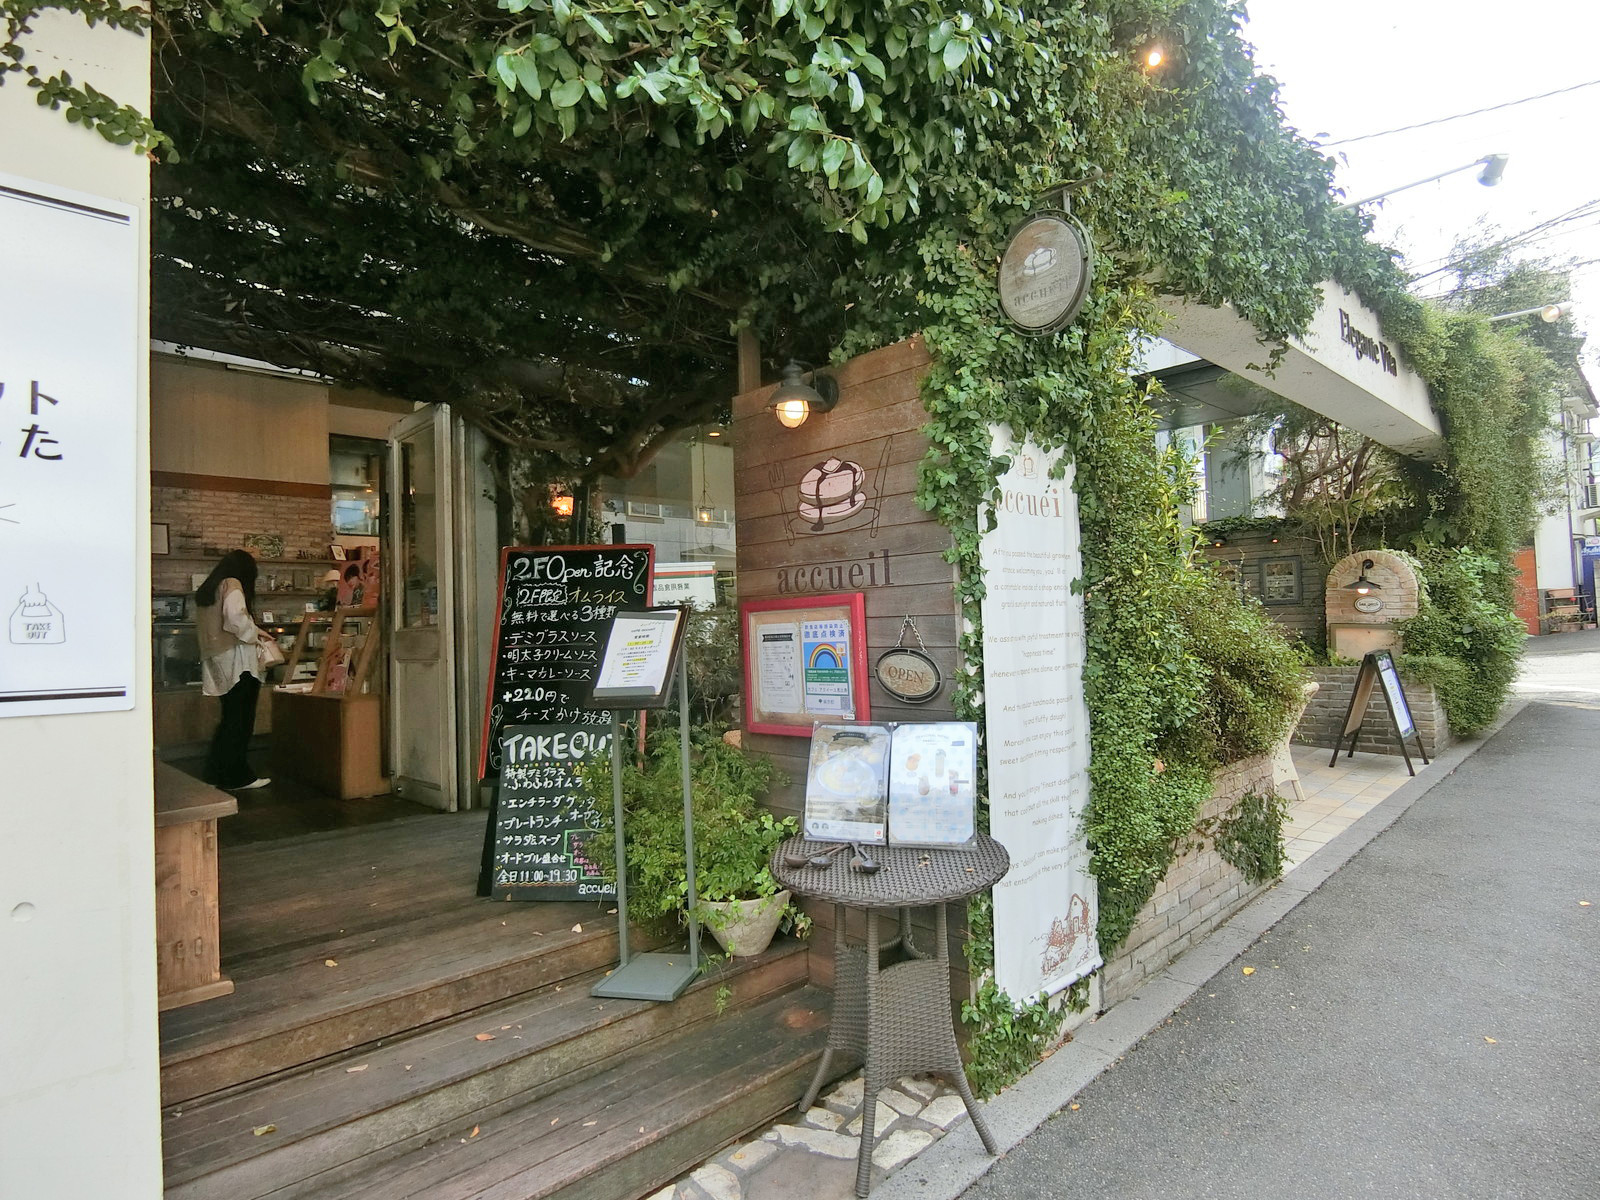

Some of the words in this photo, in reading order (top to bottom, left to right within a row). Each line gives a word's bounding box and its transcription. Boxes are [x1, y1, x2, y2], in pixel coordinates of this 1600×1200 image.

[1338, 307, 1380, 365] Elegante
[1378, 341, 1398, 378] Vita
[776, 549, 895, 594] accueil
[568, 586, 629, 604] オムライス
[24, 622, 52, 631] TAKE
[26, 631, 48, 640] OUT
[507, 649, 598, 662] 明太子クリームソース
[507, 668, 591, 681] キーマカレーソース
[887, 665, 926, 685] OPEN
[504, 813, 562, 830] プレートランチ
[500, 852, 567, 865] オードブル盛合せ
[497, 870, 517, 883] 全日
[578, 882, 617, 895] accueil
